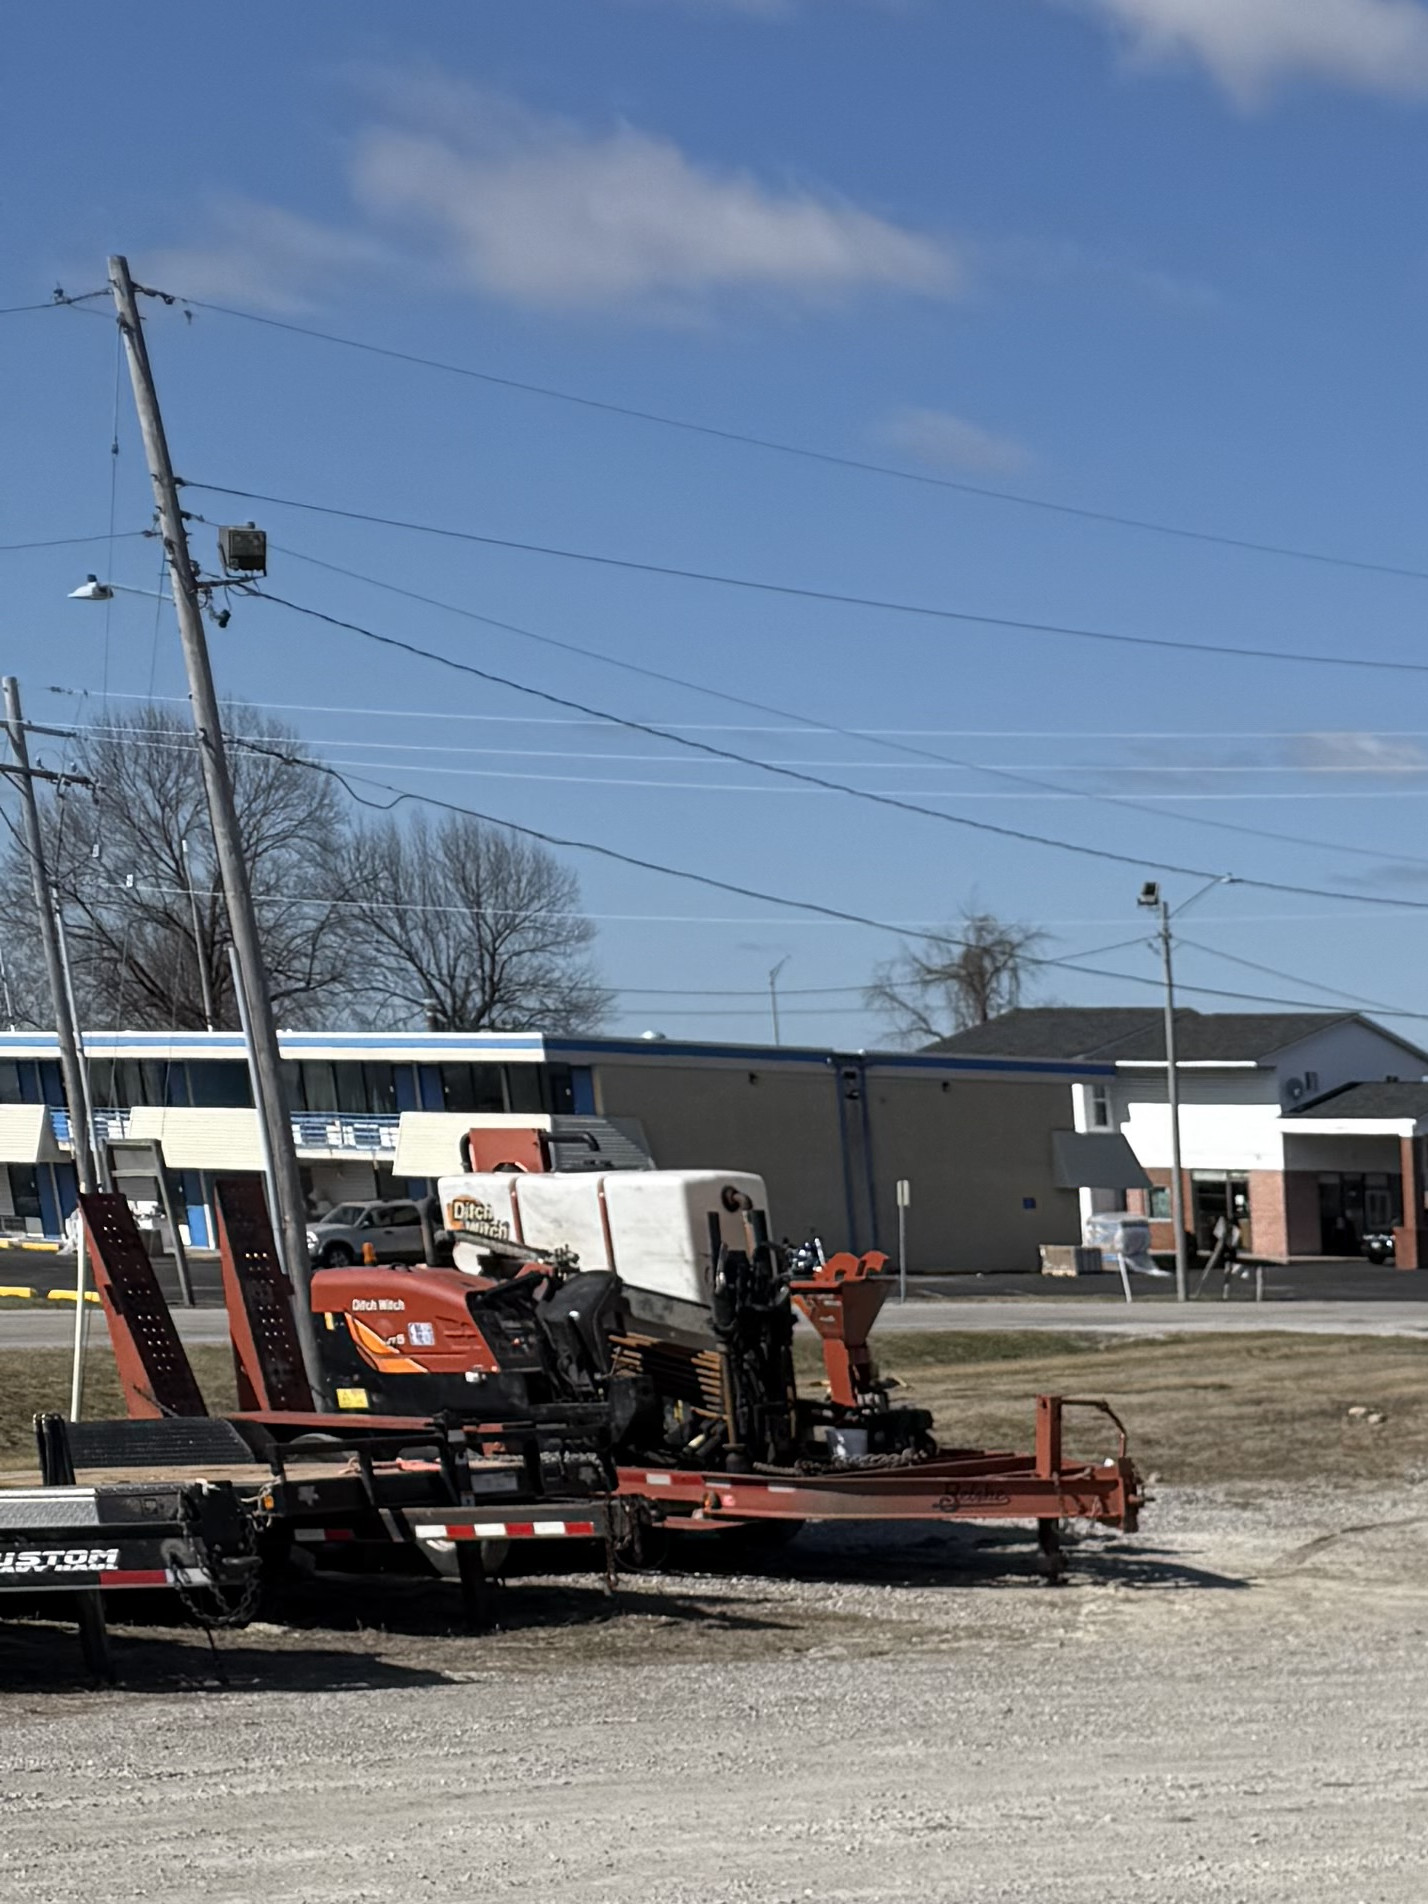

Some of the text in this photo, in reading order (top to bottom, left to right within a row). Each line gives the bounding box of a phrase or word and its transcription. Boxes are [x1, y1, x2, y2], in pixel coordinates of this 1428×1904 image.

[352, 1299, 405, 1311] Ditch Witch
[0, 1548, 120, 1567] USTOM
